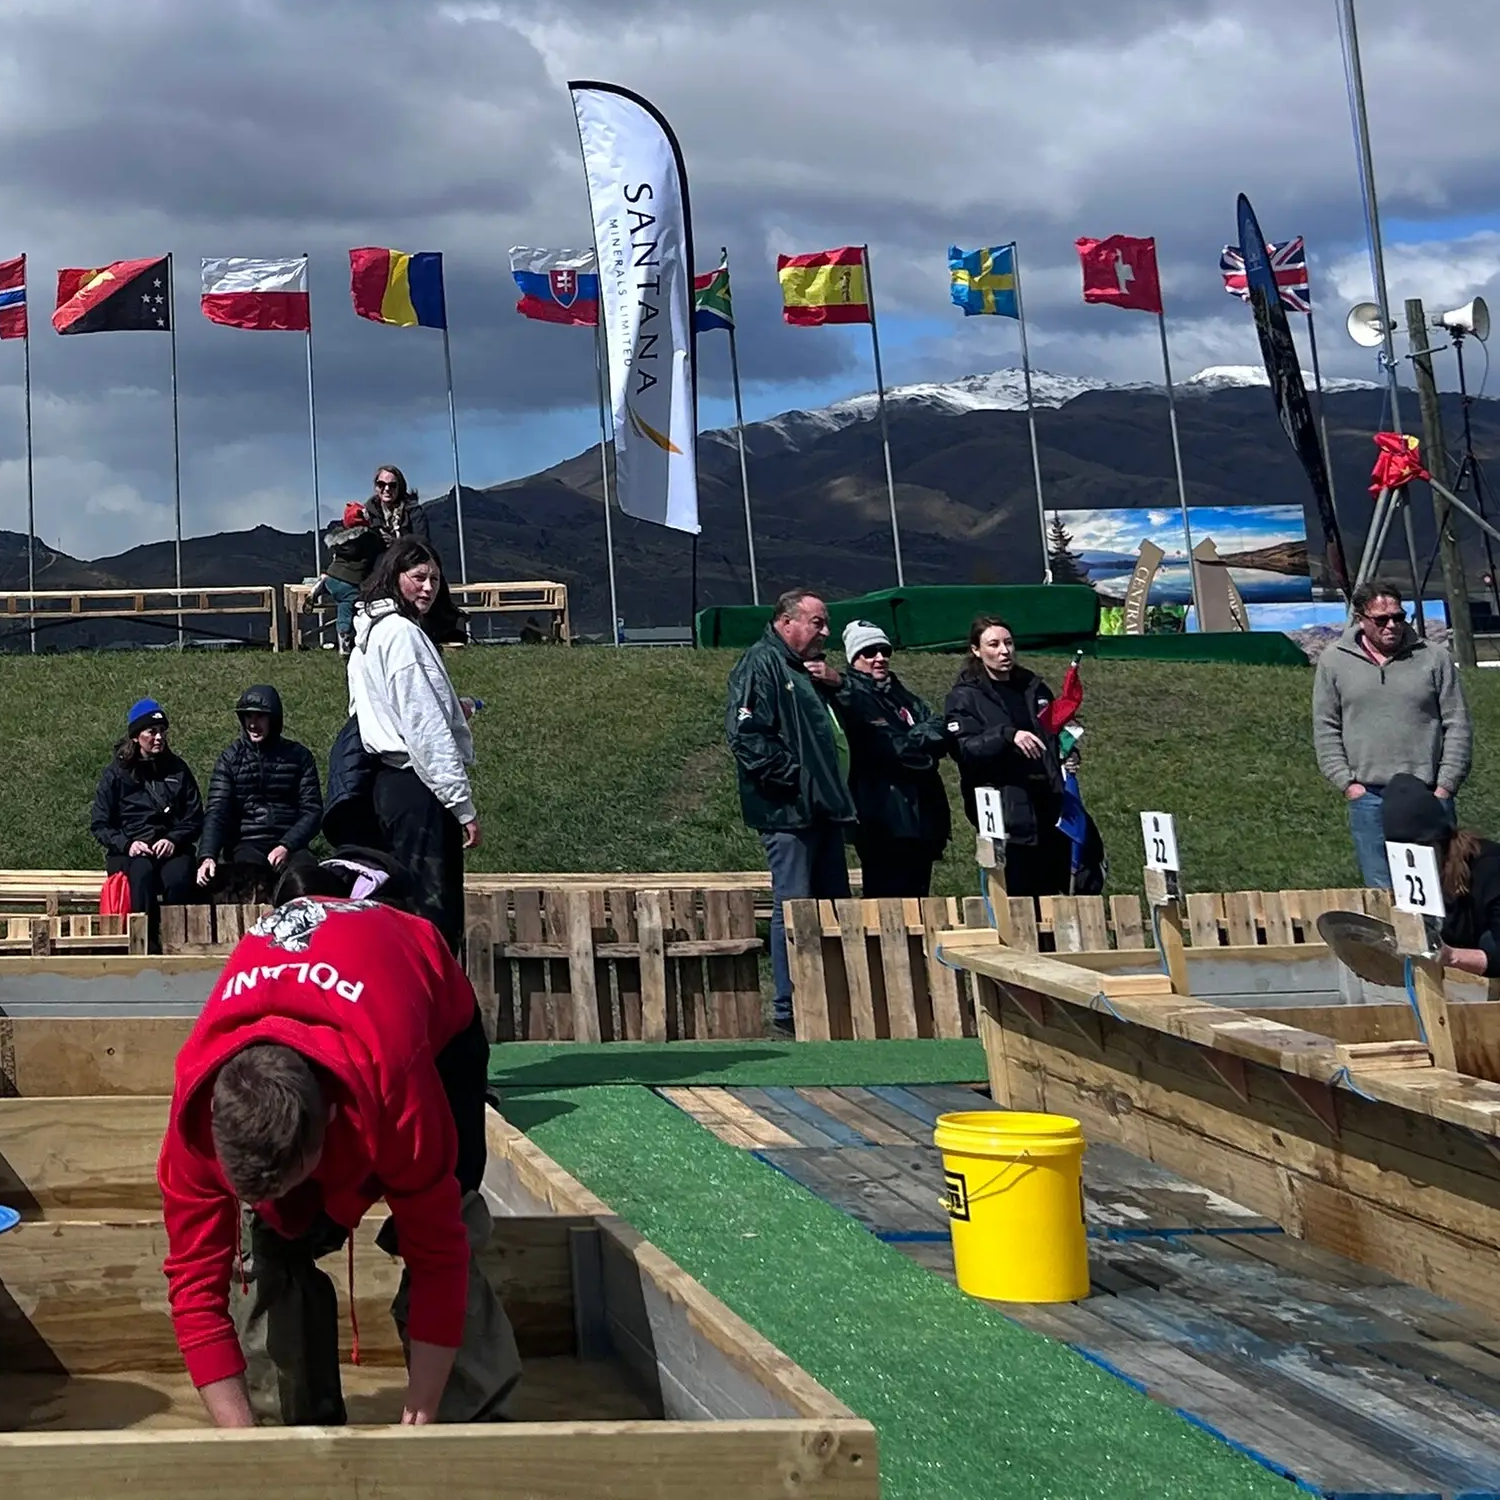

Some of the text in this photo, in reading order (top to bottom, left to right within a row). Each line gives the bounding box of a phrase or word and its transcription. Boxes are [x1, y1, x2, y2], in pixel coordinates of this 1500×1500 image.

[609, 218, 633, 367] MINERALS LIMITED
[623, 183, 660, 395] SANTANA
[984, 810, 996, 833] 21
[1152, 837, 1168, 864] 22
[1404, 873, 1426, 907] 23
